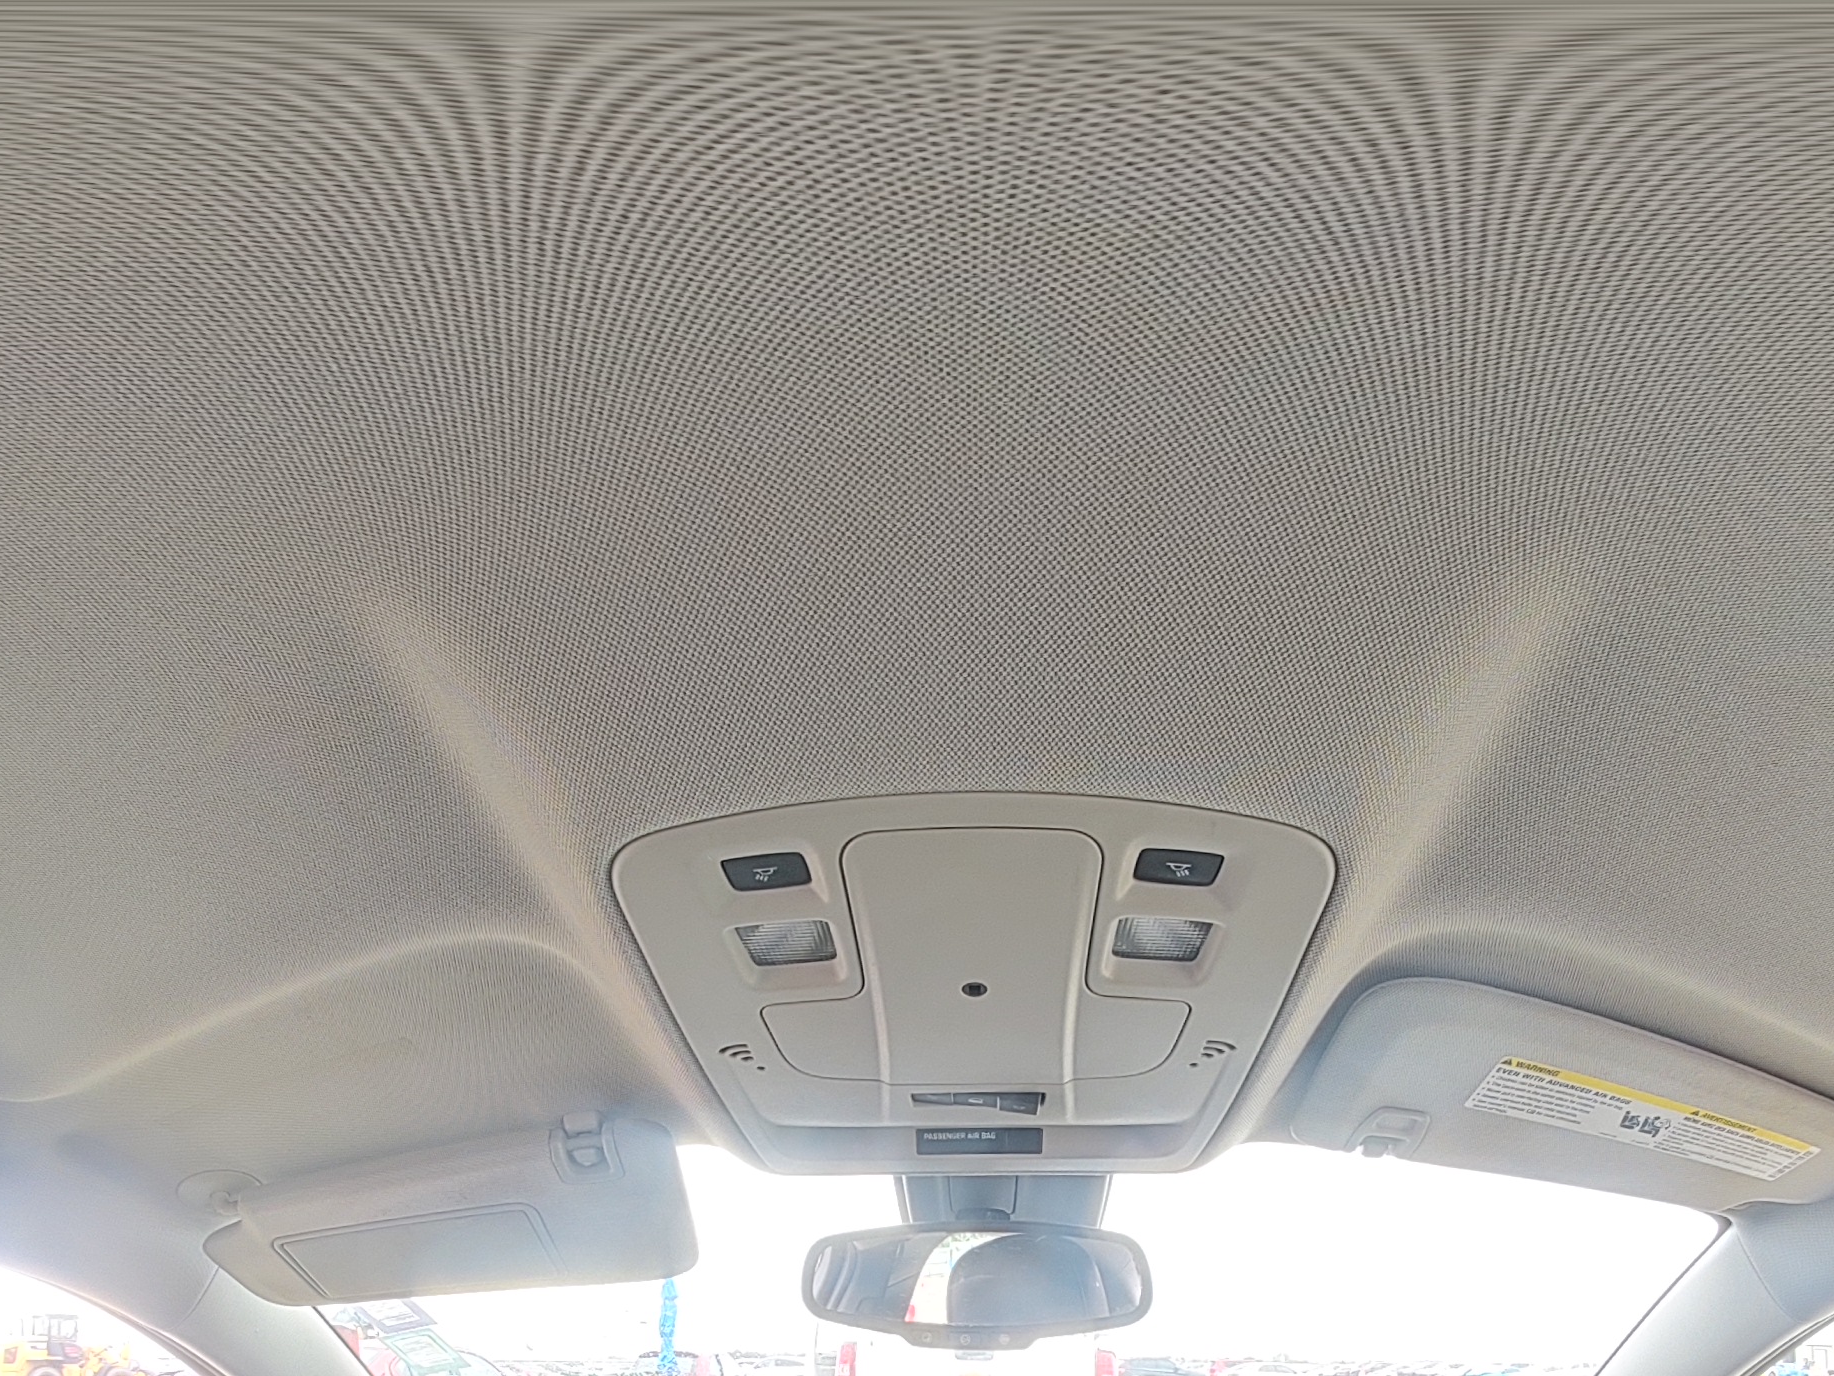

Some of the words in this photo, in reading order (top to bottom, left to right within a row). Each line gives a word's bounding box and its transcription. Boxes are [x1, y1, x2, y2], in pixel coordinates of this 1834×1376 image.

[1515, 1060, 1561, 1077] WARNING
[1495, 1067, 1520, 1078] EVEN
[1522, 1073, 1545, 1083] WITH
[1546, 1078, 1593, 1094] ADVANCED
[1592, 1091, 1608, 1099] AIR
[923, 1132, 966, 1140] PASSENGER
[967, 1132, 980, 1140] AIR
[981, 1131, 996, 1139] BAG
